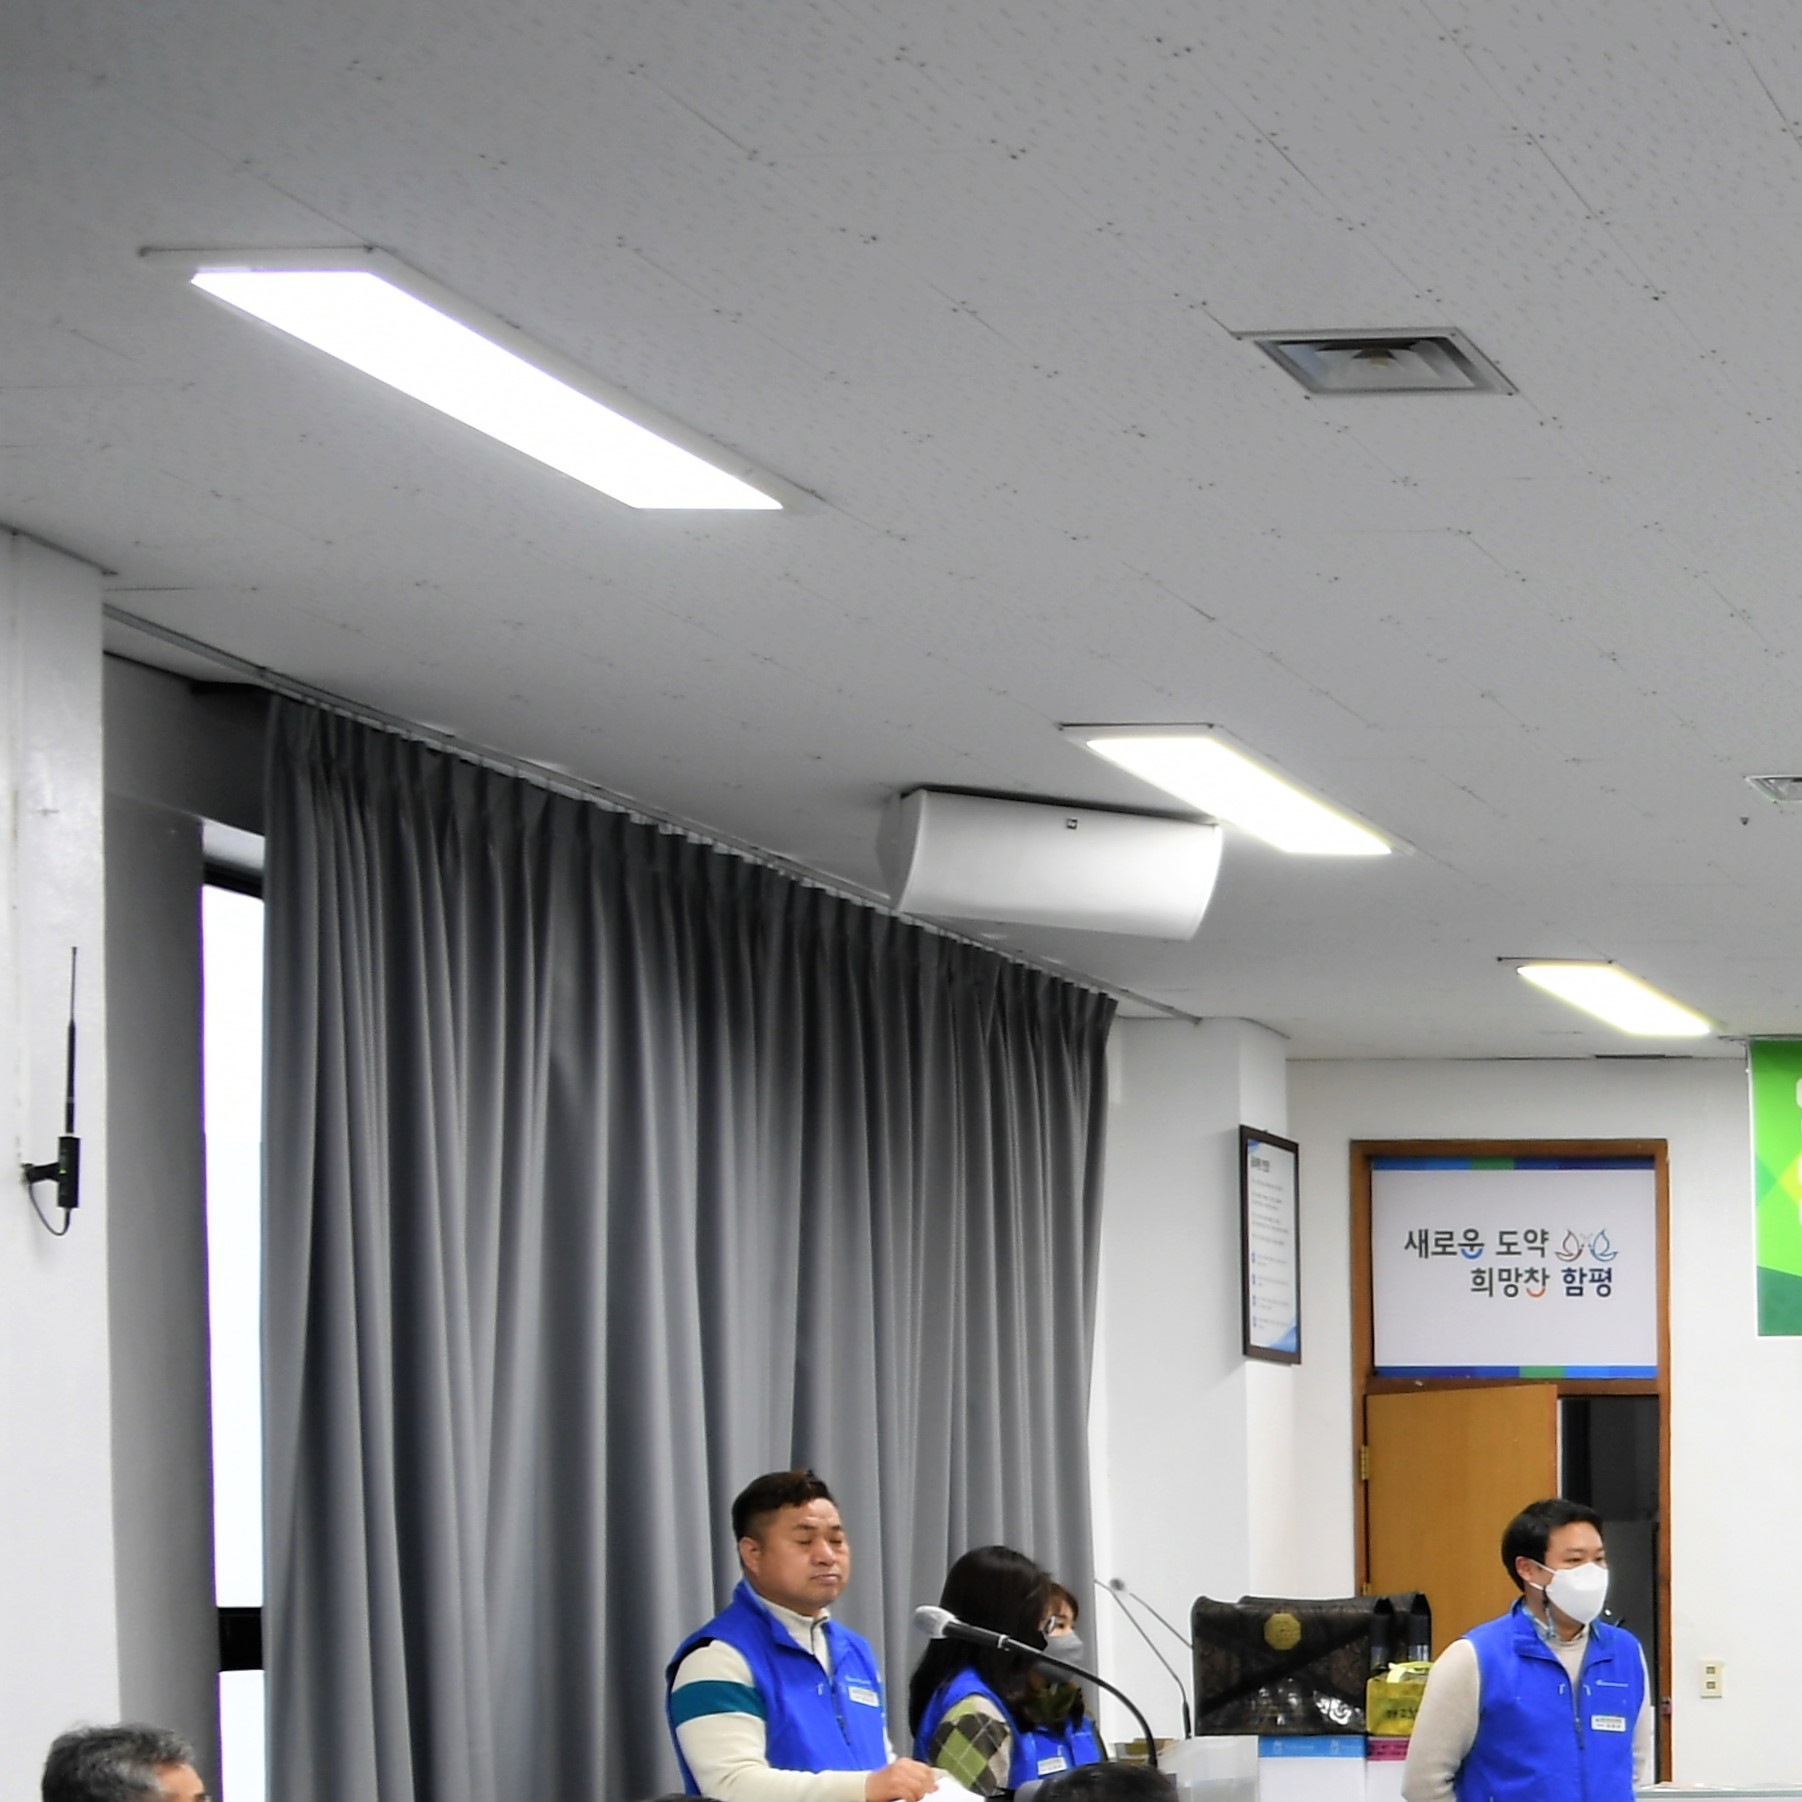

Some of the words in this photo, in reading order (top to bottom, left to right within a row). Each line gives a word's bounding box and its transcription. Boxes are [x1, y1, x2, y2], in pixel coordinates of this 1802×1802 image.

[1405, 1229, 1484, 1259] 새로운
[1496, 1229, 1549, 1257] 도약
[1471, 1267, 1550, 1297] 희망찬
[1562, 1267, 1613, 1297] 함평
